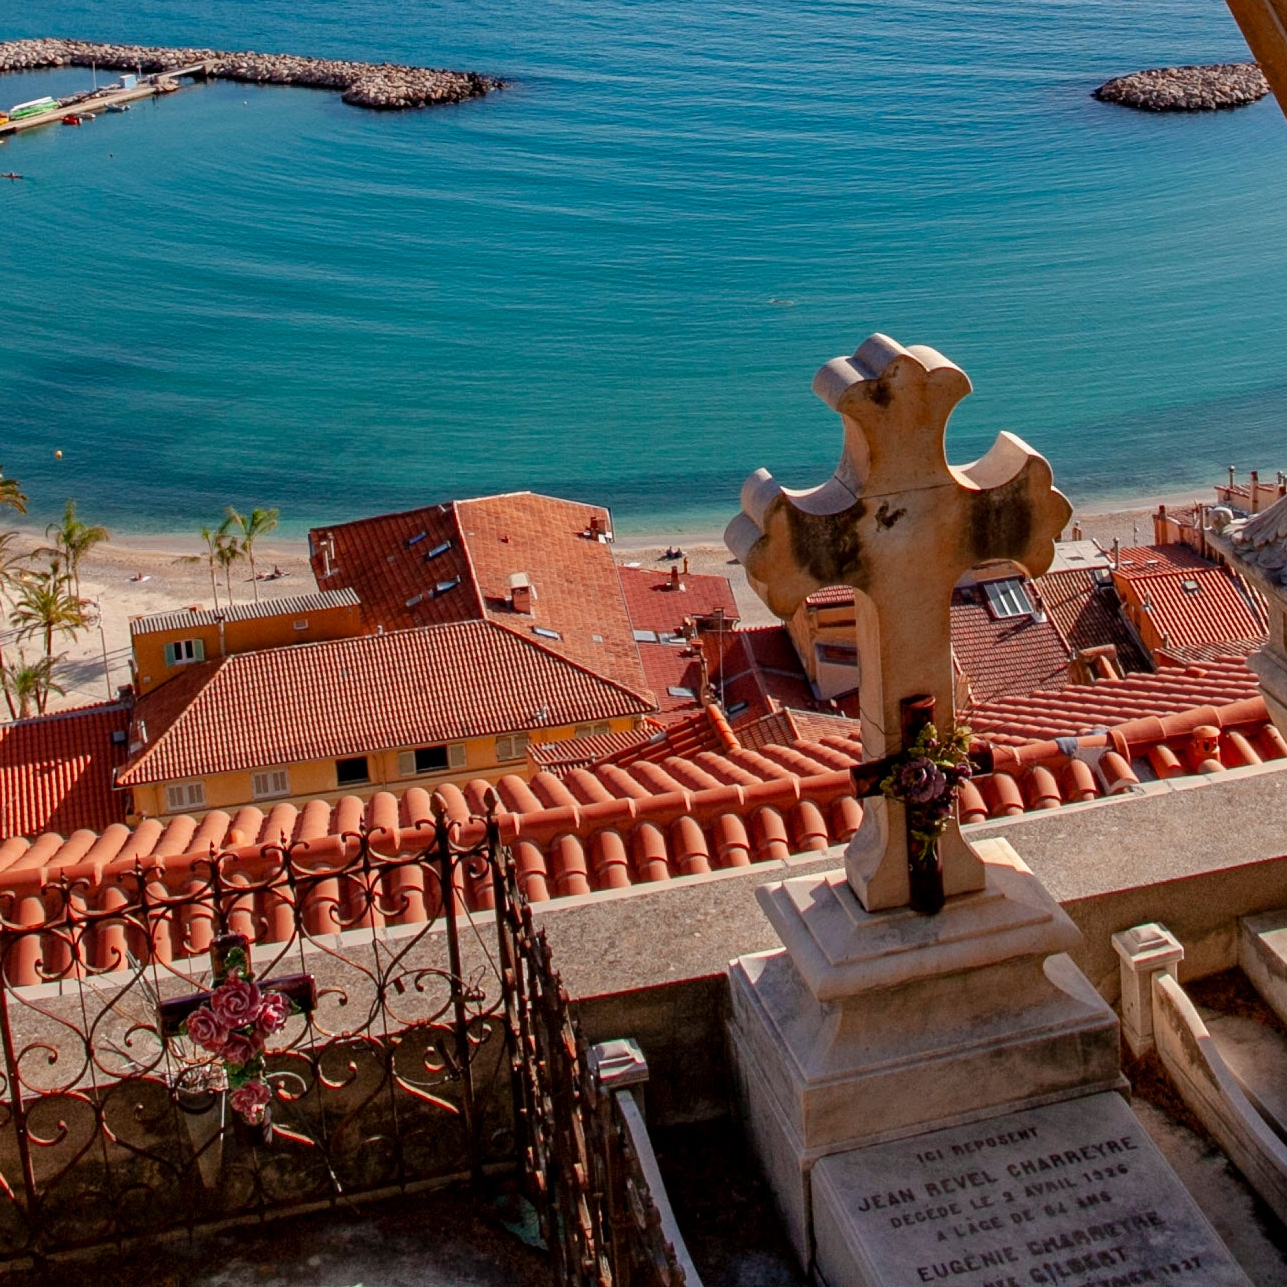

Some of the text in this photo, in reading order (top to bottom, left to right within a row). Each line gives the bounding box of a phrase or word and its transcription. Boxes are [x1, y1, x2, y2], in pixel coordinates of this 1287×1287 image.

[916, 1127, 1039, 1164] ICI REPOSENT
[858, 1136, 1140, 1213] JEAN REVEL CHARREYRE
[969, 1193, 995, 1211] LE
[1024, 1176, 1078, 1199] AVRIL
[1009, 1208, 1036, 1225] DE
[1076, 1190, 1113, 1210] ANS
